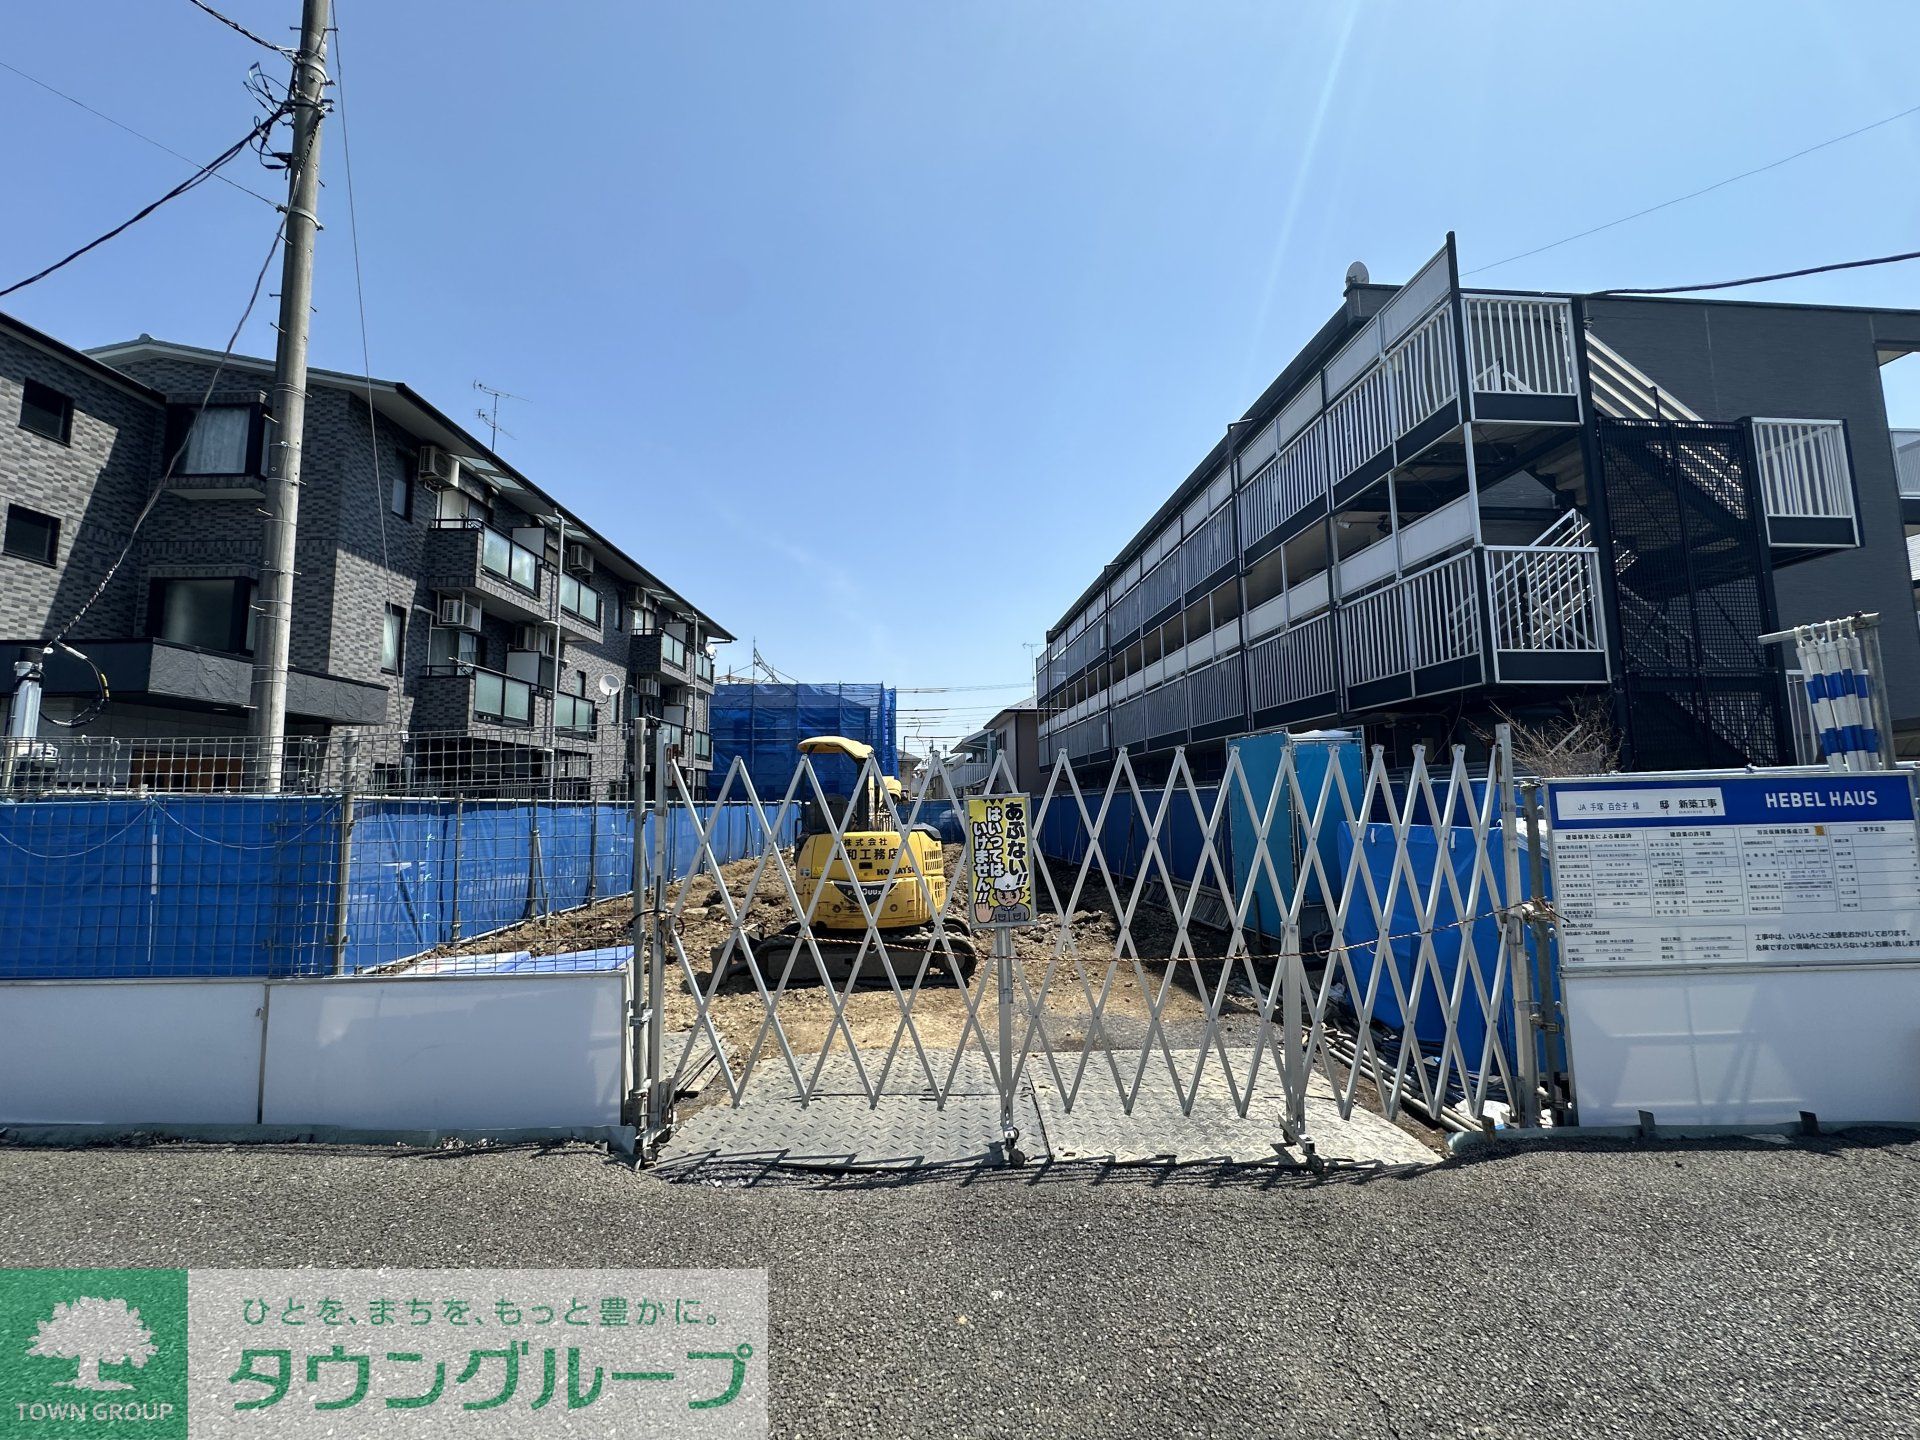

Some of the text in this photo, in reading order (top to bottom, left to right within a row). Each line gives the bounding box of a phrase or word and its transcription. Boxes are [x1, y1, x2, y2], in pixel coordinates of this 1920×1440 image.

[1659, 799, 1670, 810] 邸
[1678, 798, 1717, 809] 新築工事
[1765, 790, 1878, 808] HEBEL HAUS
[843, 837, 888, 847] 株式会社
[876, 865, 916, 876] KOATS
